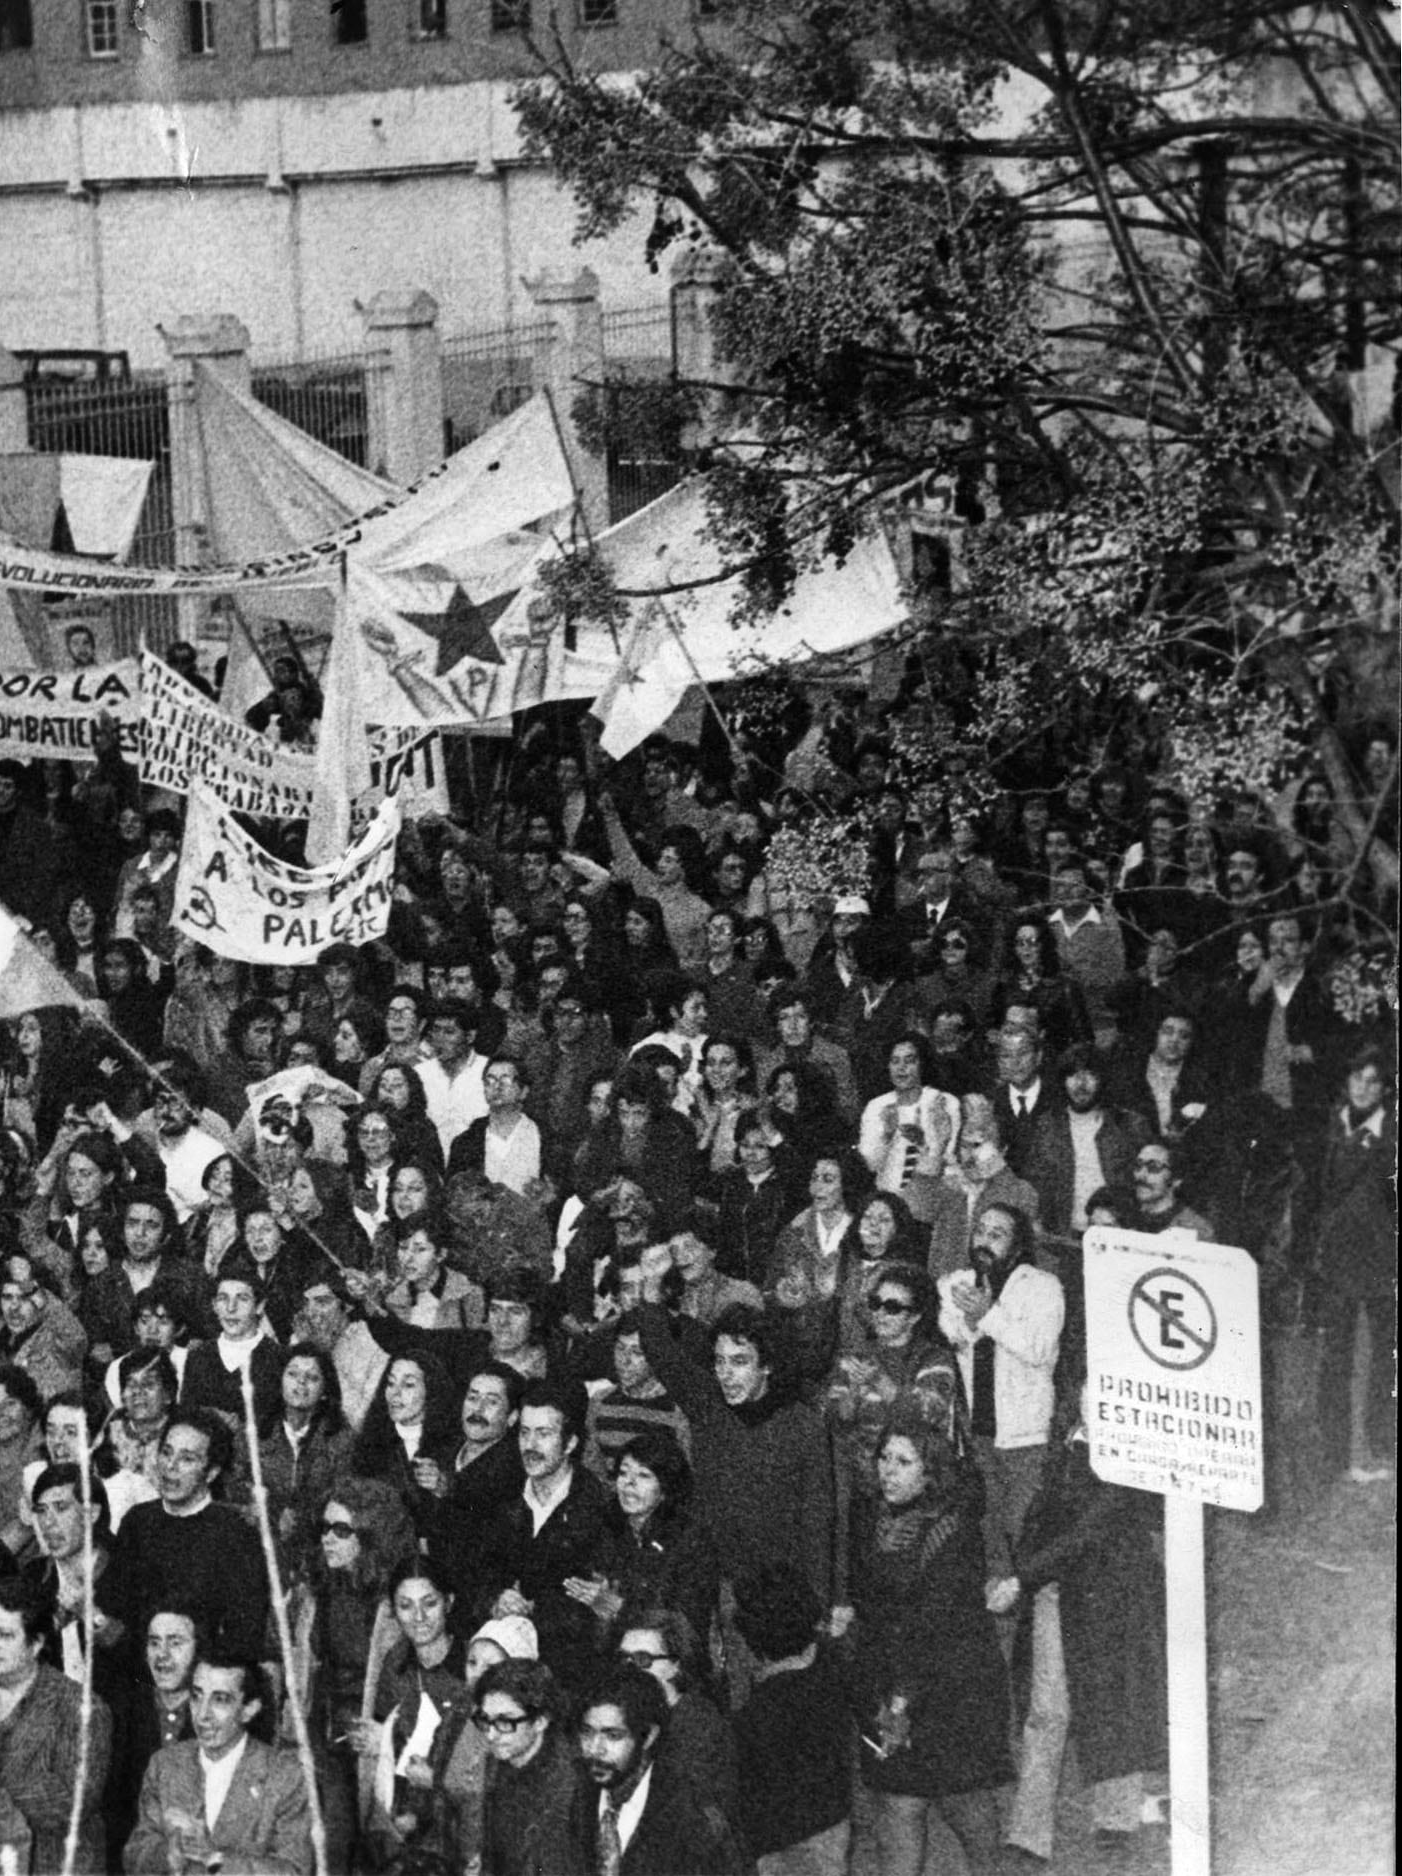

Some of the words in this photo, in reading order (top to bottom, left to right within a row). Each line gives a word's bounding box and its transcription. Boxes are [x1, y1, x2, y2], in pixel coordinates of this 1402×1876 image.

[72, 673, 131, 703] LA
[141, 760, 190, 788] LOS
[204, 850, 228, 884] A
[1100, 1374, 1253, 1421] PROHIBIDO
[1099, 1401, 1256, 1451] ESTACIONAR
